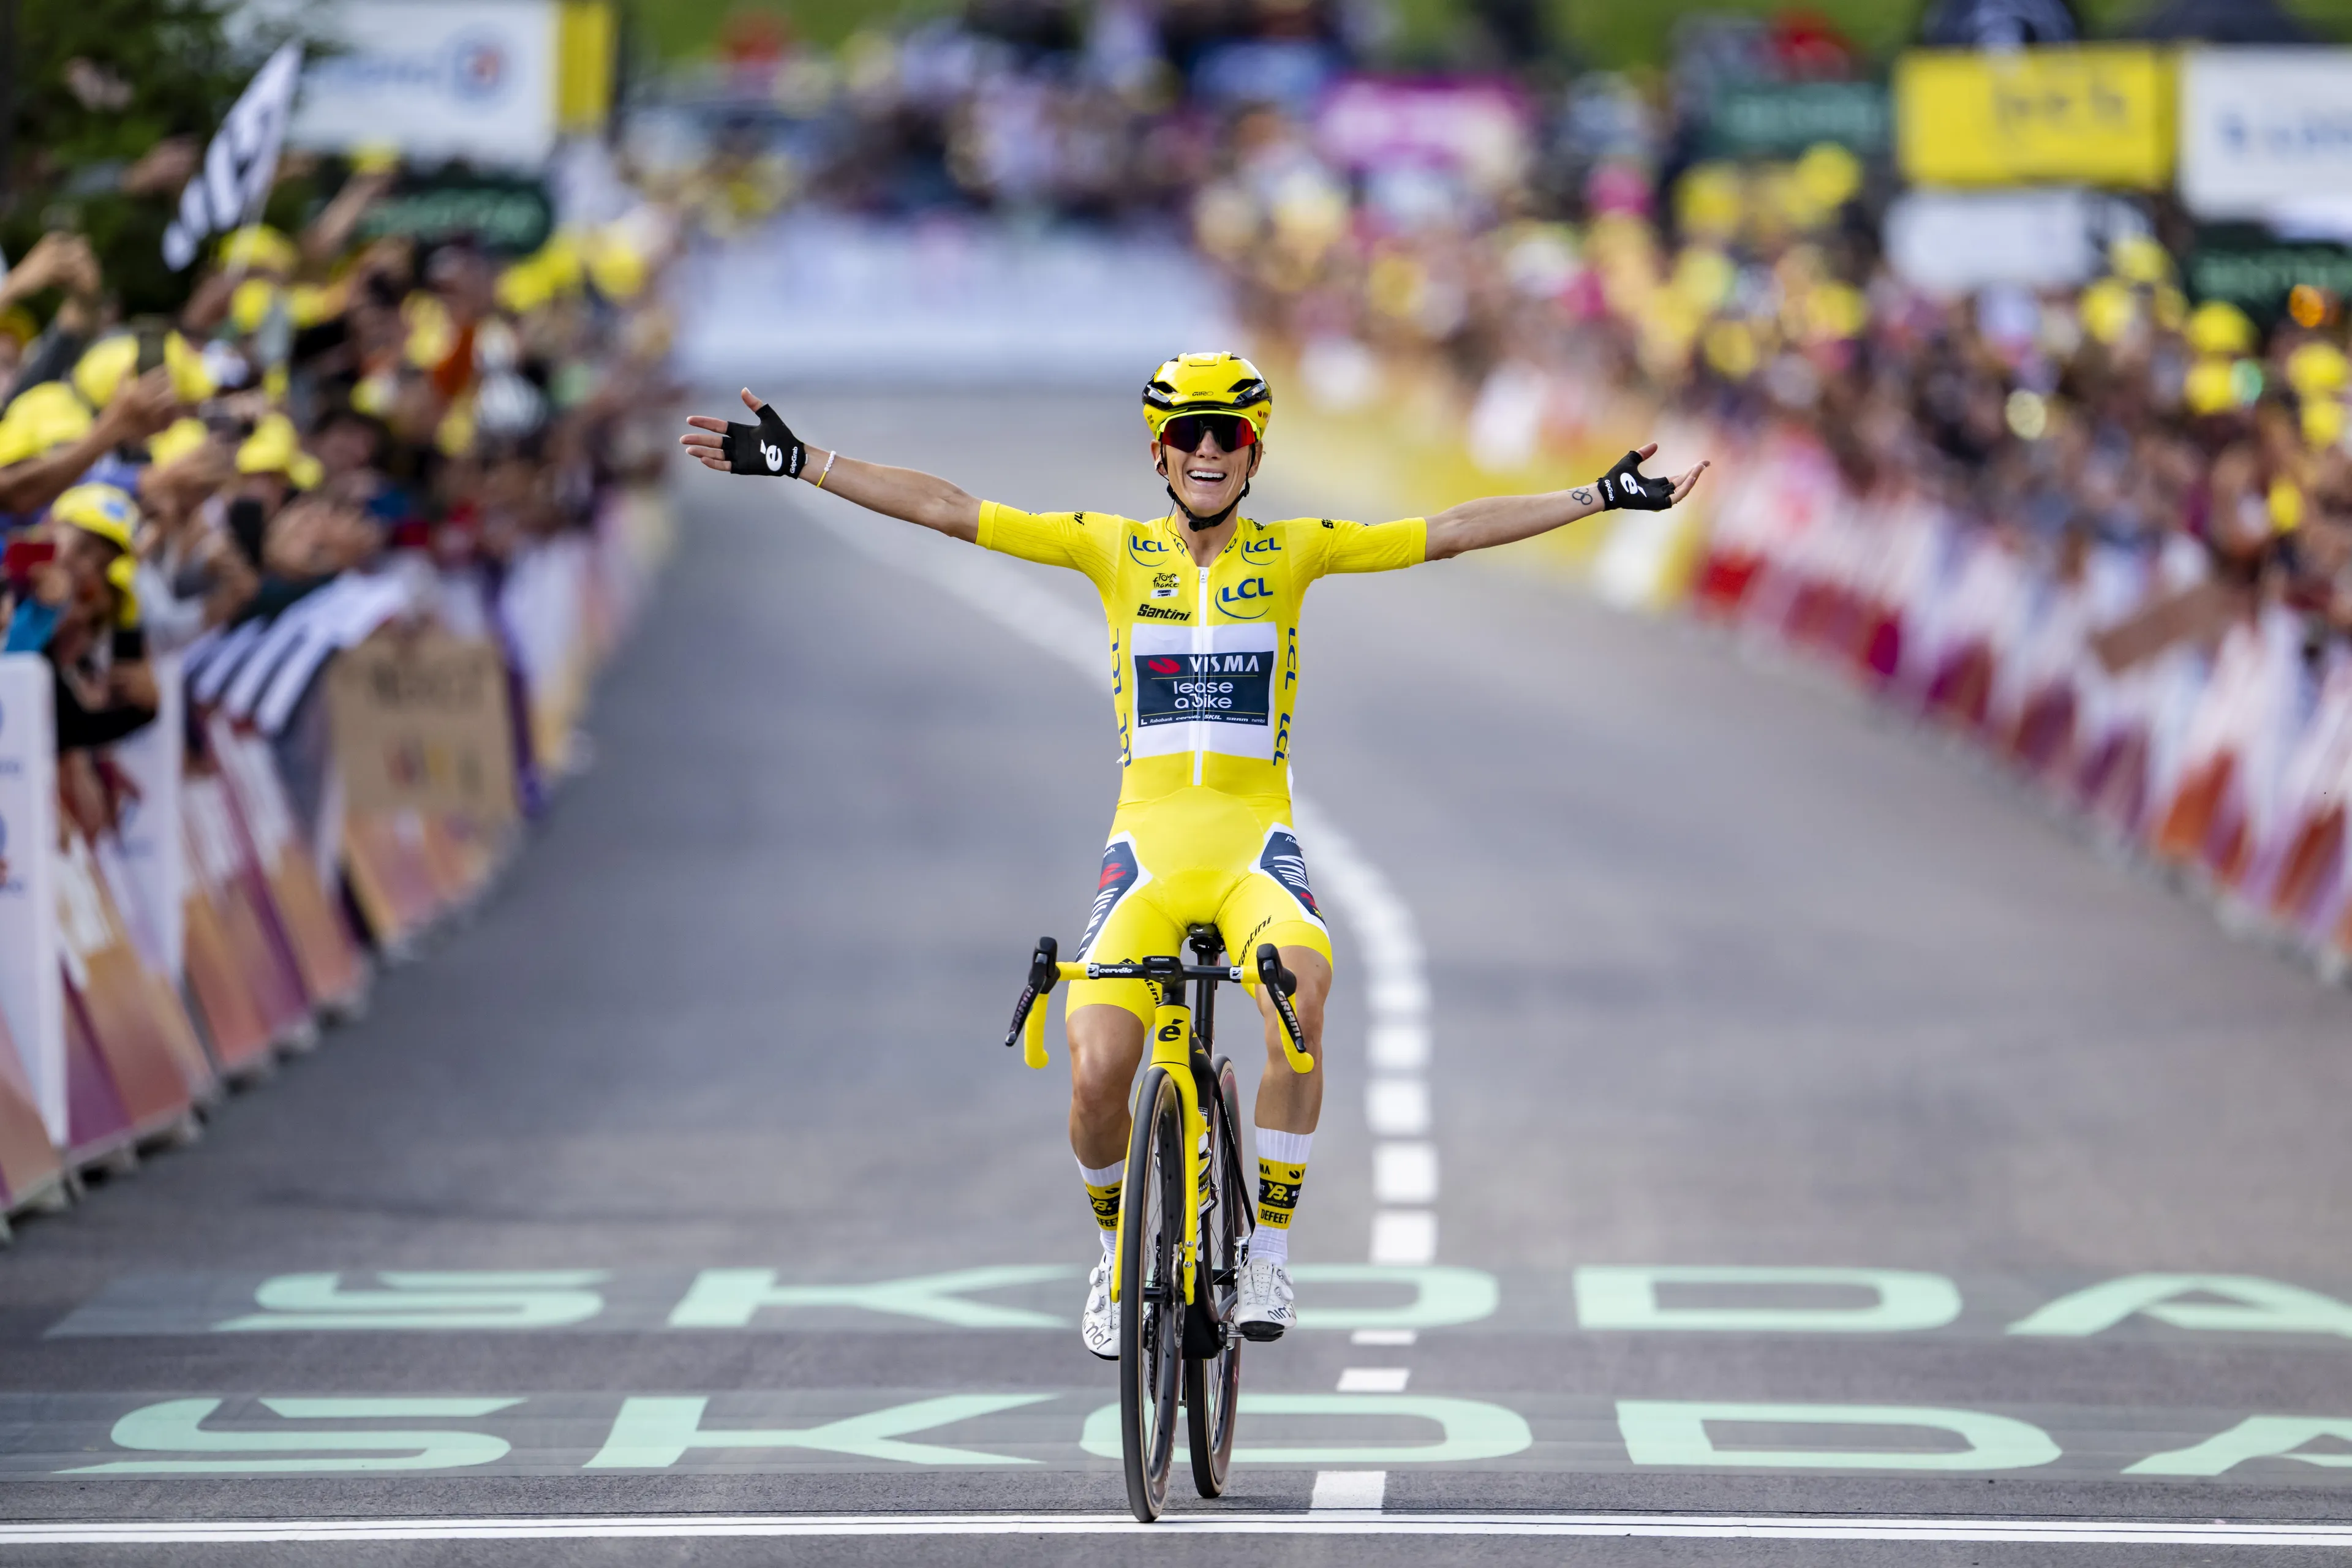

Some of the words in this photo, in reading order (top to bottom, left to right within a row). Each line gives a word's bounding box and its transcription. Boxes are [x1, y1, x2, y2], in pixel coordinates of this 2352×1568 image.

[790, 446, 798, 473] GripGrab
[1604, 479, 1615, 502] GripGrab
[1133, 535, 1169, 552] LCL
[1245, 537, 1282, 553] LCL
[1223, 578, 1273, 603] LCL
[1137, 603, 1191, 621] Santini
[1112, 628, 1122, 696] LCL
[1189, 655, 1259, 673] VISMA
[1284, 627, 1296, 690] LCL
[1174, 681, 1234, 695] lease
[1119, 712, 1131, 768] LCL
[1273, 712, 1291, 766] LCL
[1275, 990, 1301, 1038] SRAM
[1261, 1208, 1289, 1224] DEFEET
